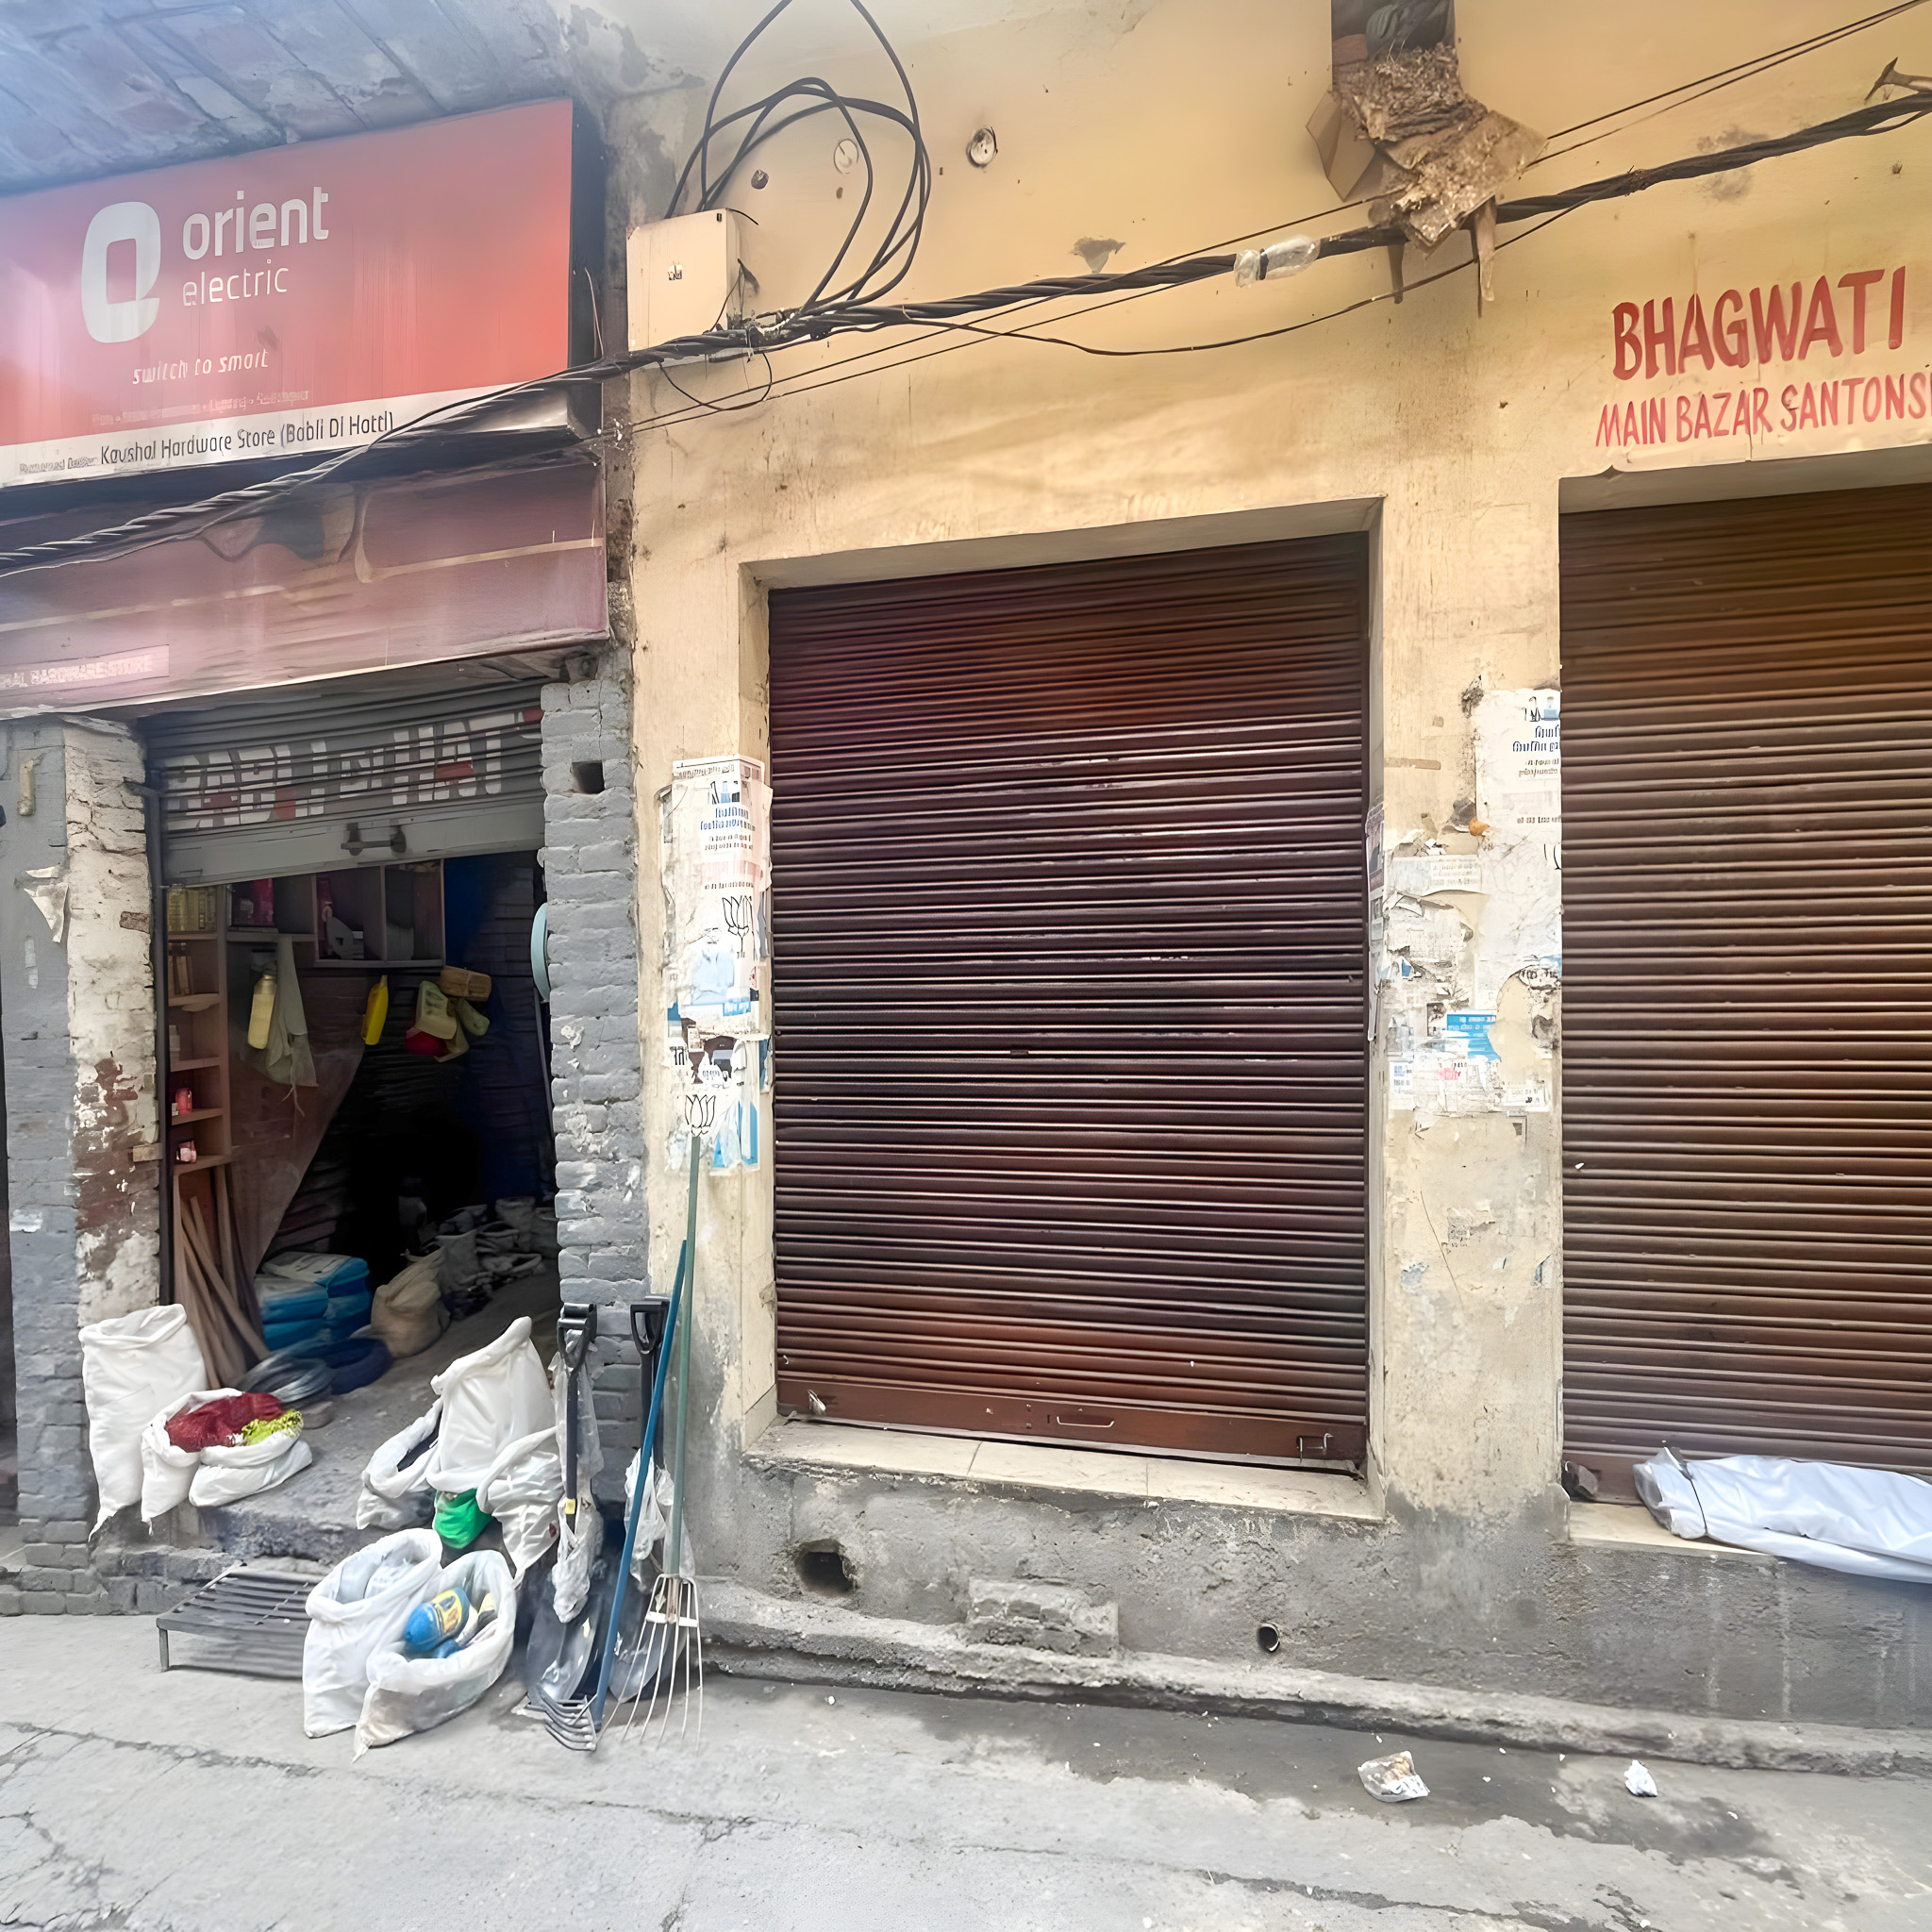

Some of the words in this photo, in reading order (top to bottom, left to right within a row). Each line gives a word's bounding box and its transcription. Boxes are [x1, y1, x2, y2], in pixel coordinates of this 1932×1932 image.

[183, 187, 329, 260] orient
[183, 259, 289, 307] electric
[1612, 265, 1906, 381] BHAGWATI
[132, 359, 189, 385] switch
[195, 358, 212, 376] to
[1595, 396, 1667, 447] MAIN
[1675, 387, 1774, 442] BAZAR
[1779, 371, 1932, 432] SANTONS
[161, 434, 232, 459] Hardware
[237, 428, 275, 450] Store
